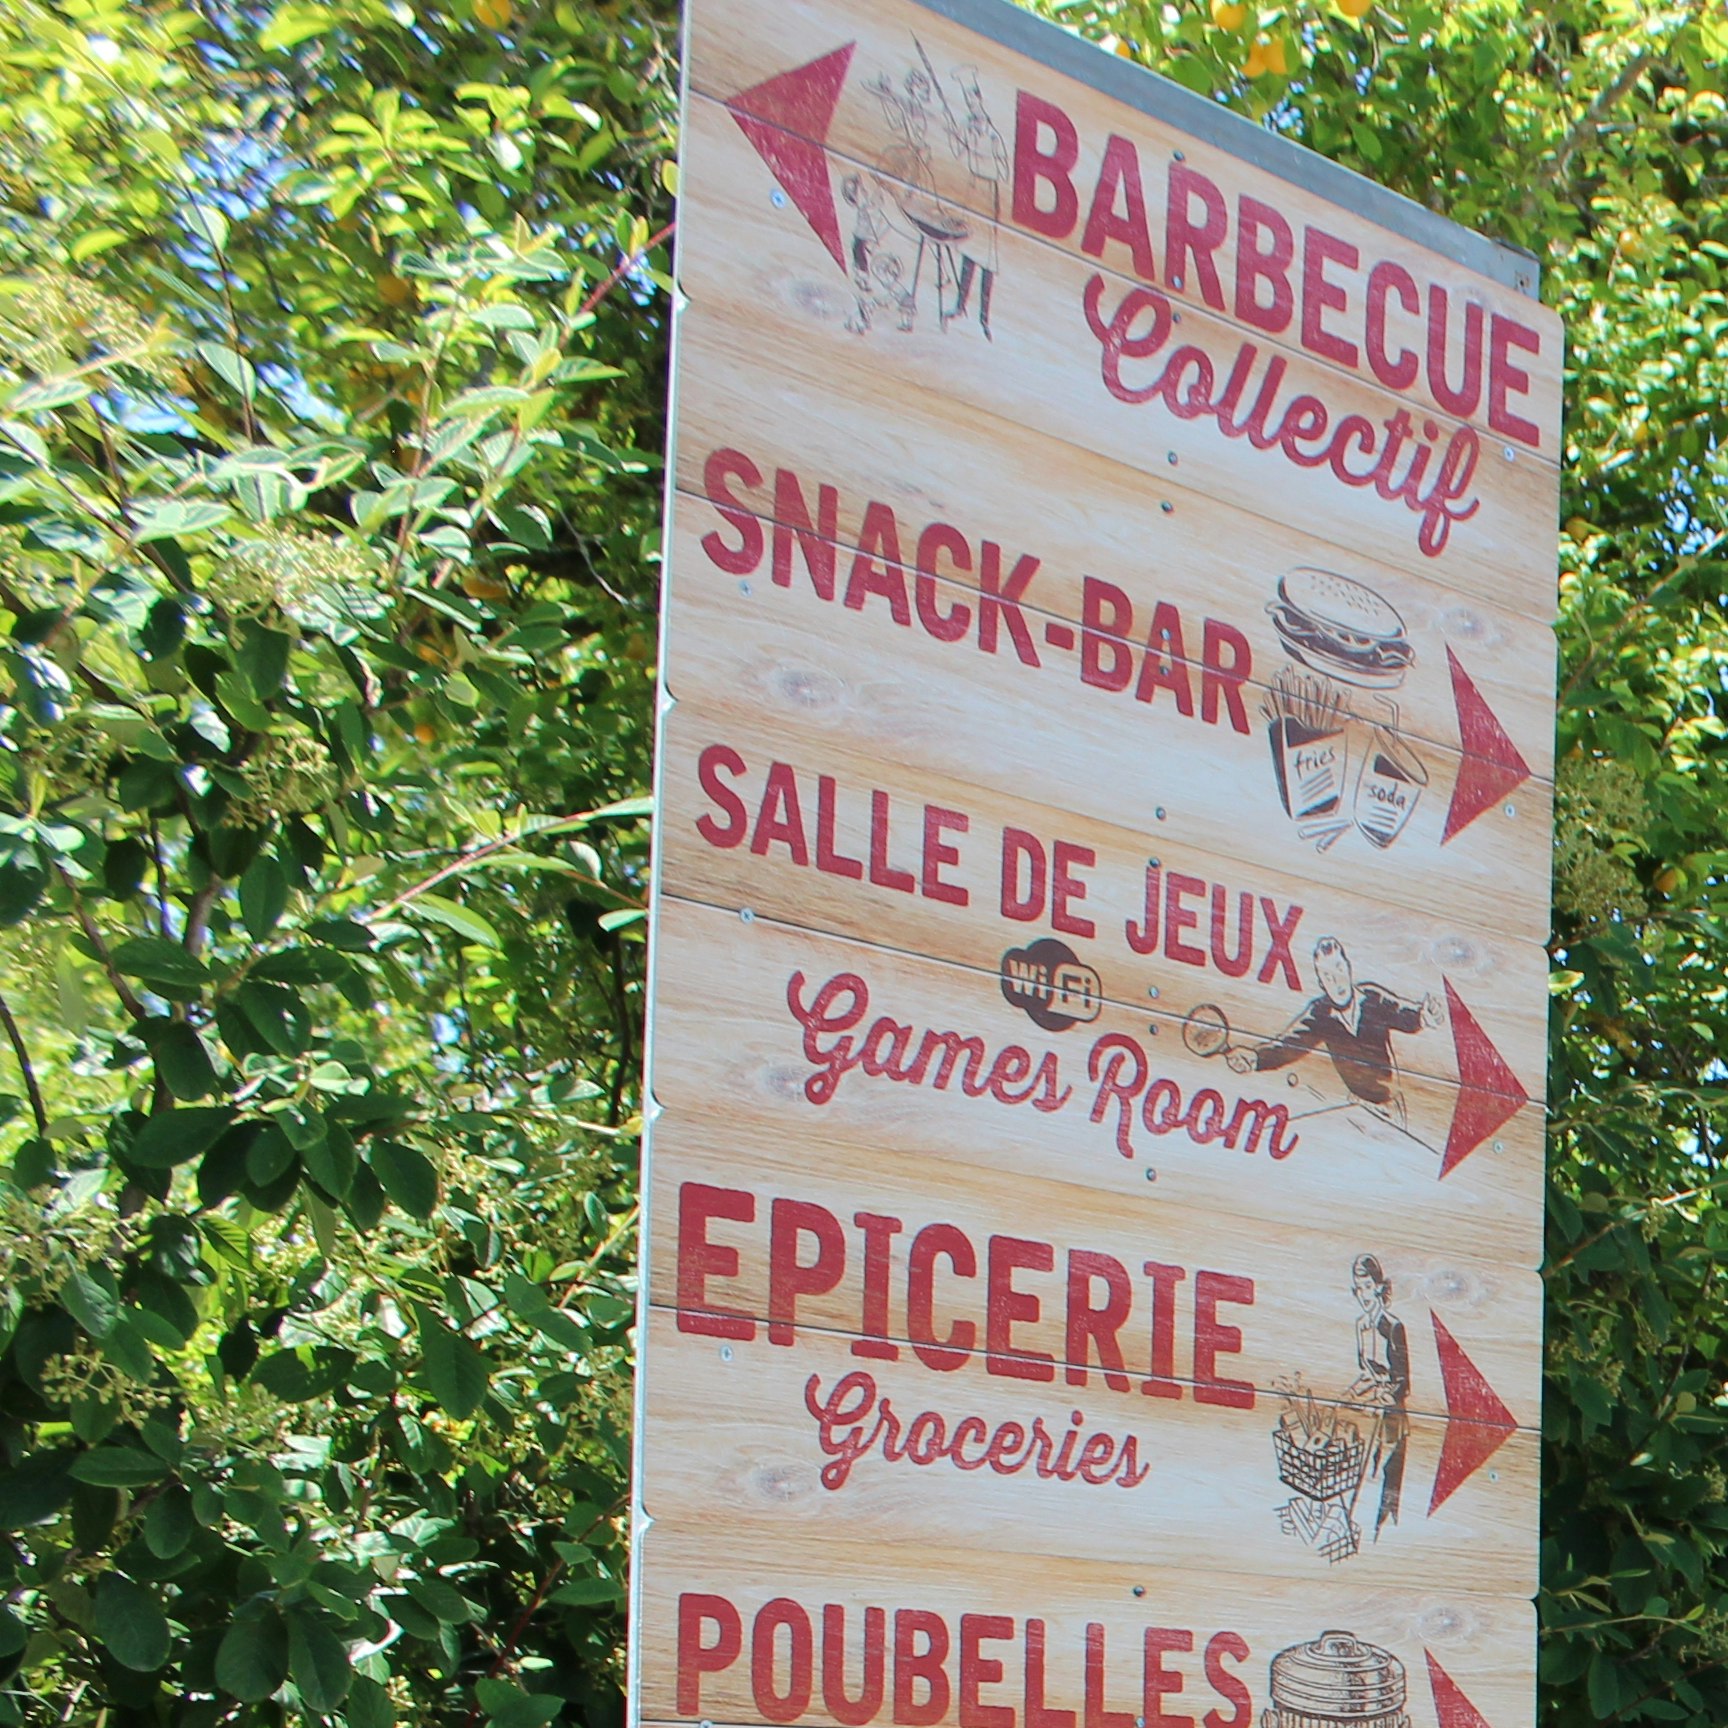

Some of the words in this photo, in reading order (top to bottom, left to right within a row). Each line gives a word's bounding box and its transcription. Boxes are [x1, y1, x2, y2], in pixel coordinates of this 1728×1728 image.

[1010, 89, 1541, 447] BARBECUE
[1083, 273, 1480, 557] Collectif
[700, 447, 1252, 736] SNACK-BAR
[695, 744, 970, 907] SALLE
[1000, 826, 1096, 939] DE
[1125, 862, 1304, 991] JEUX
[1294, 747, 1336, 781] fries
[1368, 781, 1406, 810] soda
[787, 970, 1072, 1112] Games
[1088, 1032, 1299, 1160] Room
[676, 1181, 1256, 1410] EPICERIE
[805, 1371, 1149, 1490] Groceries
